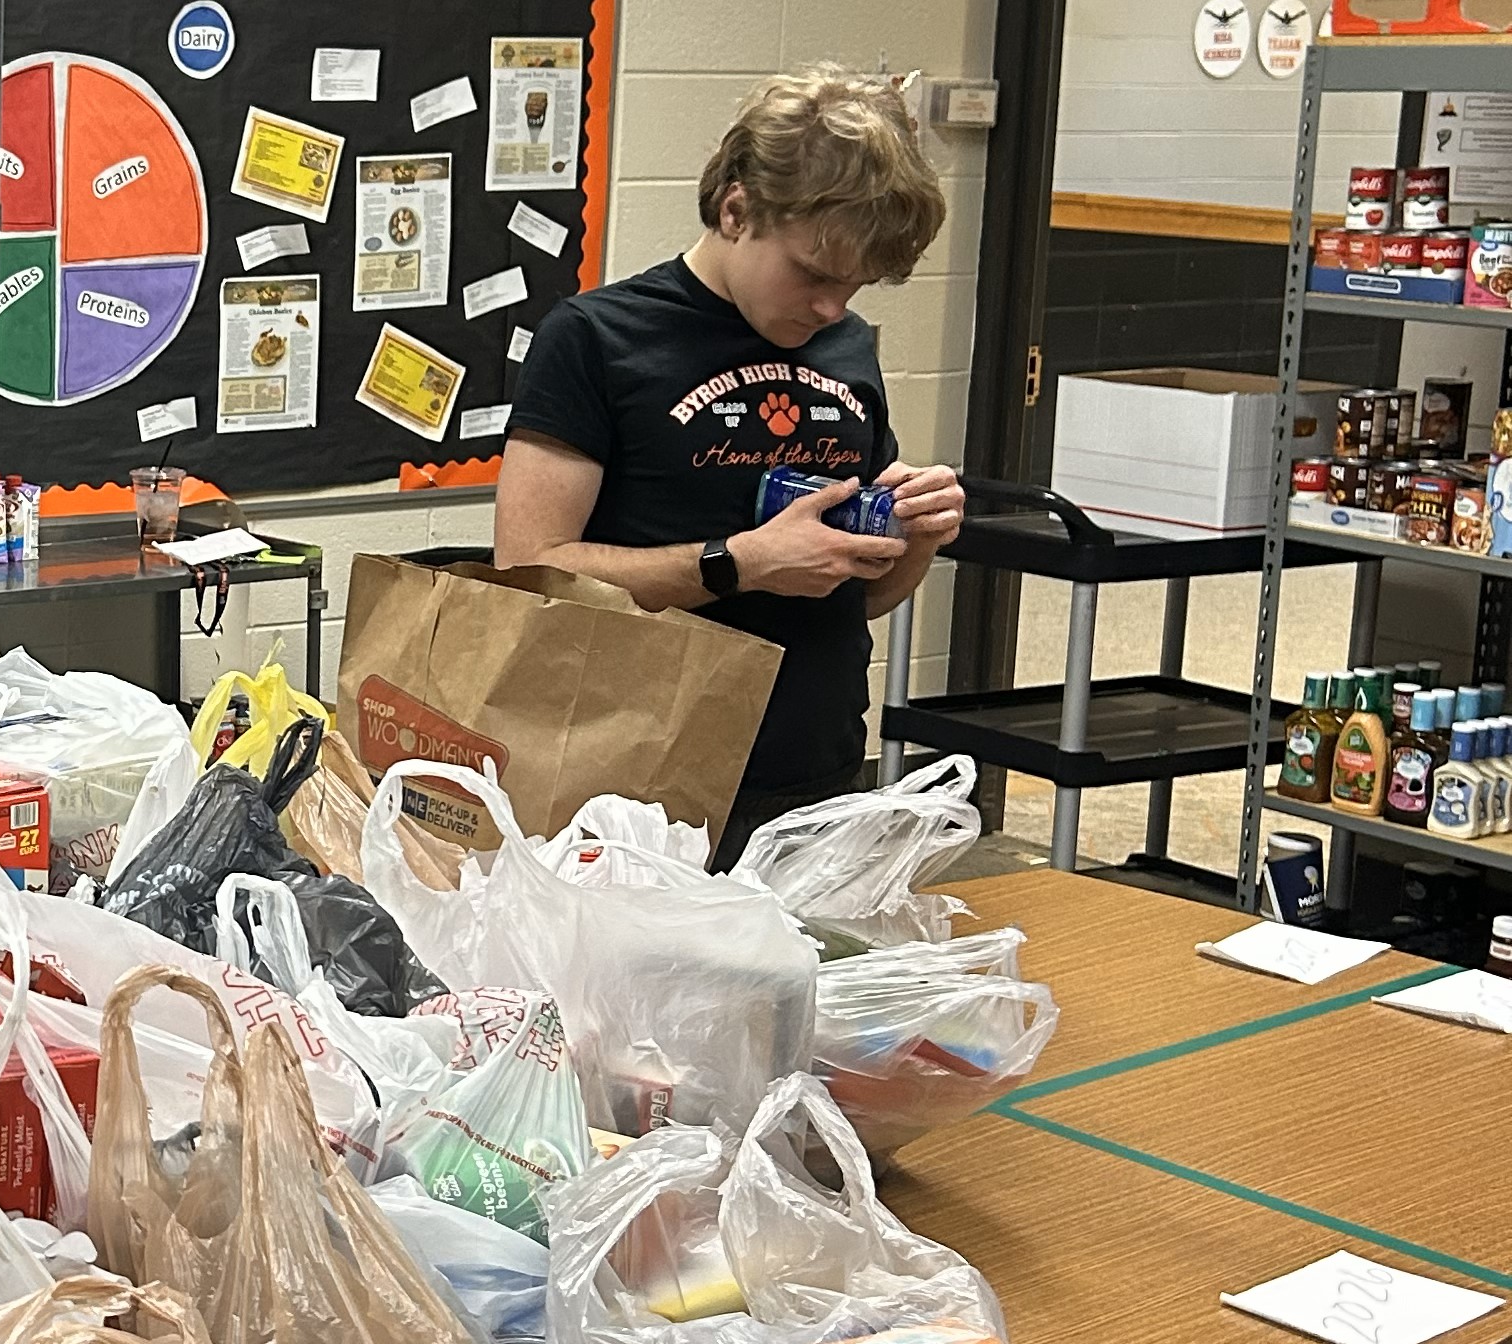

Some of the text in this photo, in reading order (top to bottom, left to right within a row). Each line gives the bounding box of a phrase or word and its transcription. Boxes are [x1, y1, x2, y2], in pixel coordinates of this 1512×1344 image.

[180, 29, 223, 50] Dairy
[94, 159, 148, 196] Grains
[80, 293, 146, 325] Proteins
[669, 363, 867, 425] BYRON HIGH SCHOOL
[692, 438, 862, 469] Home of the Tigers
[363, 698, 395, 718] SHOP
[427, 811, 477, 839] DELIVERY
[429, 798, 470, 821] PICK-UP
[19, 829, 39, 845] 27
[19, 845, 40, 856] CUPS
[473, 1152, 496, 1195] green
[490, 1161, 509, 1209] beans
[1322, 1268, 1394, 1344] 2026
